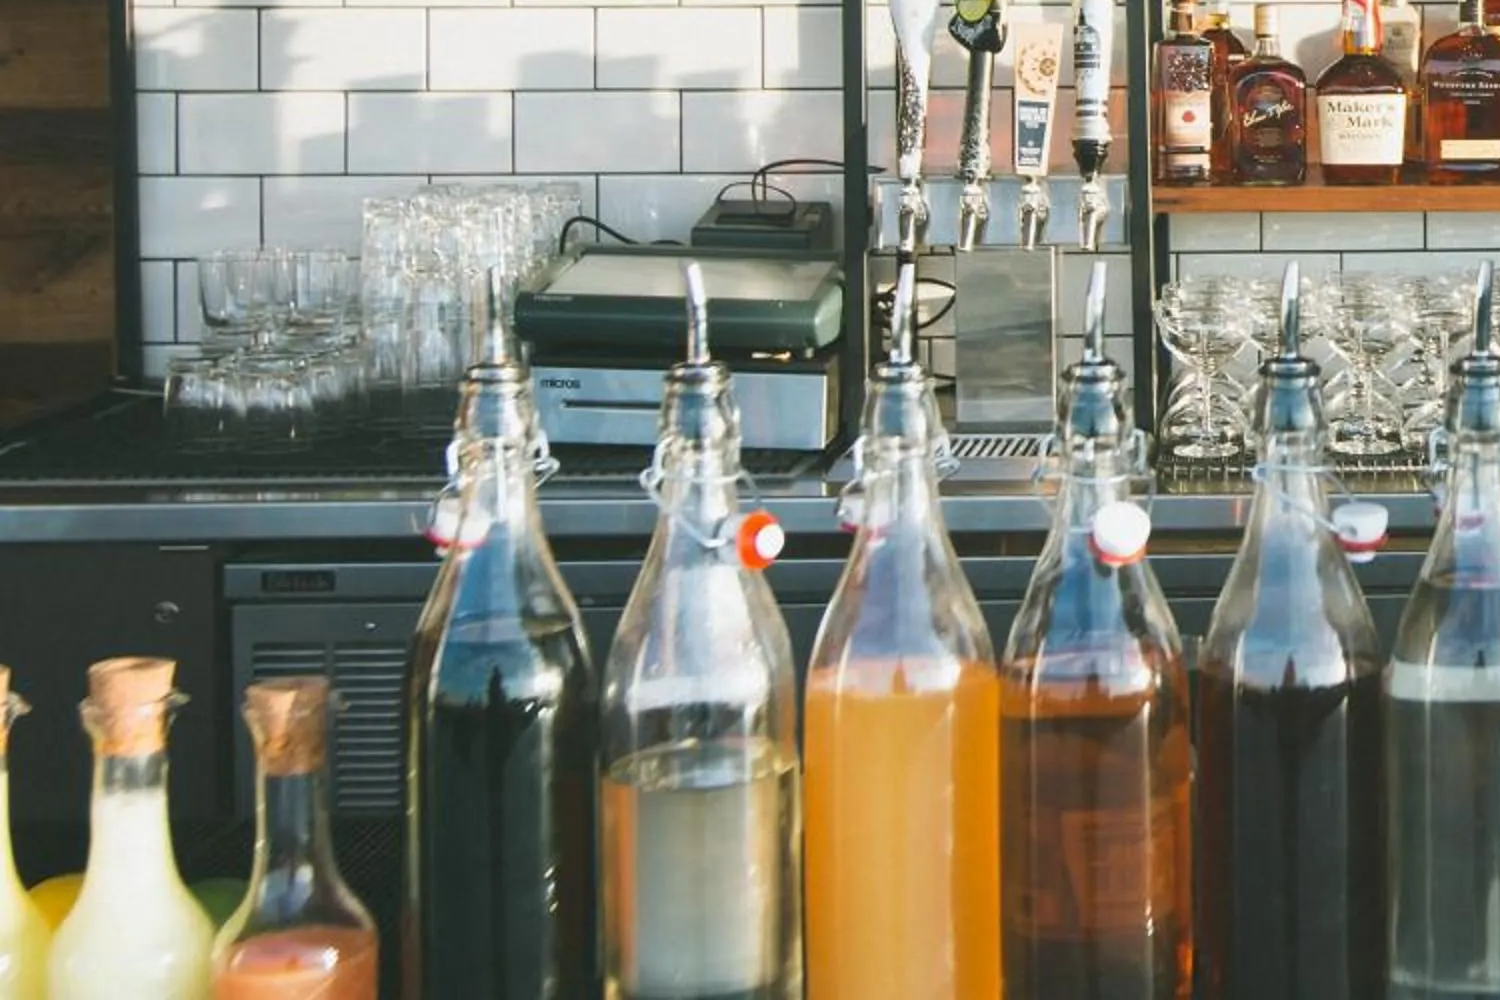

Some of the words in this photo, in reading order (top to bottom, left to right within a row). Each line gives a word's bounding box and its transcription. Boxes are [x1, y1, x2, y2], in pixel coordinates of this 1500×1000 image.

[1327, 101, 1396, 113] Maker's
[1345, 115, 1393, 129] Mark
[540, 378, 581, 389] micros
